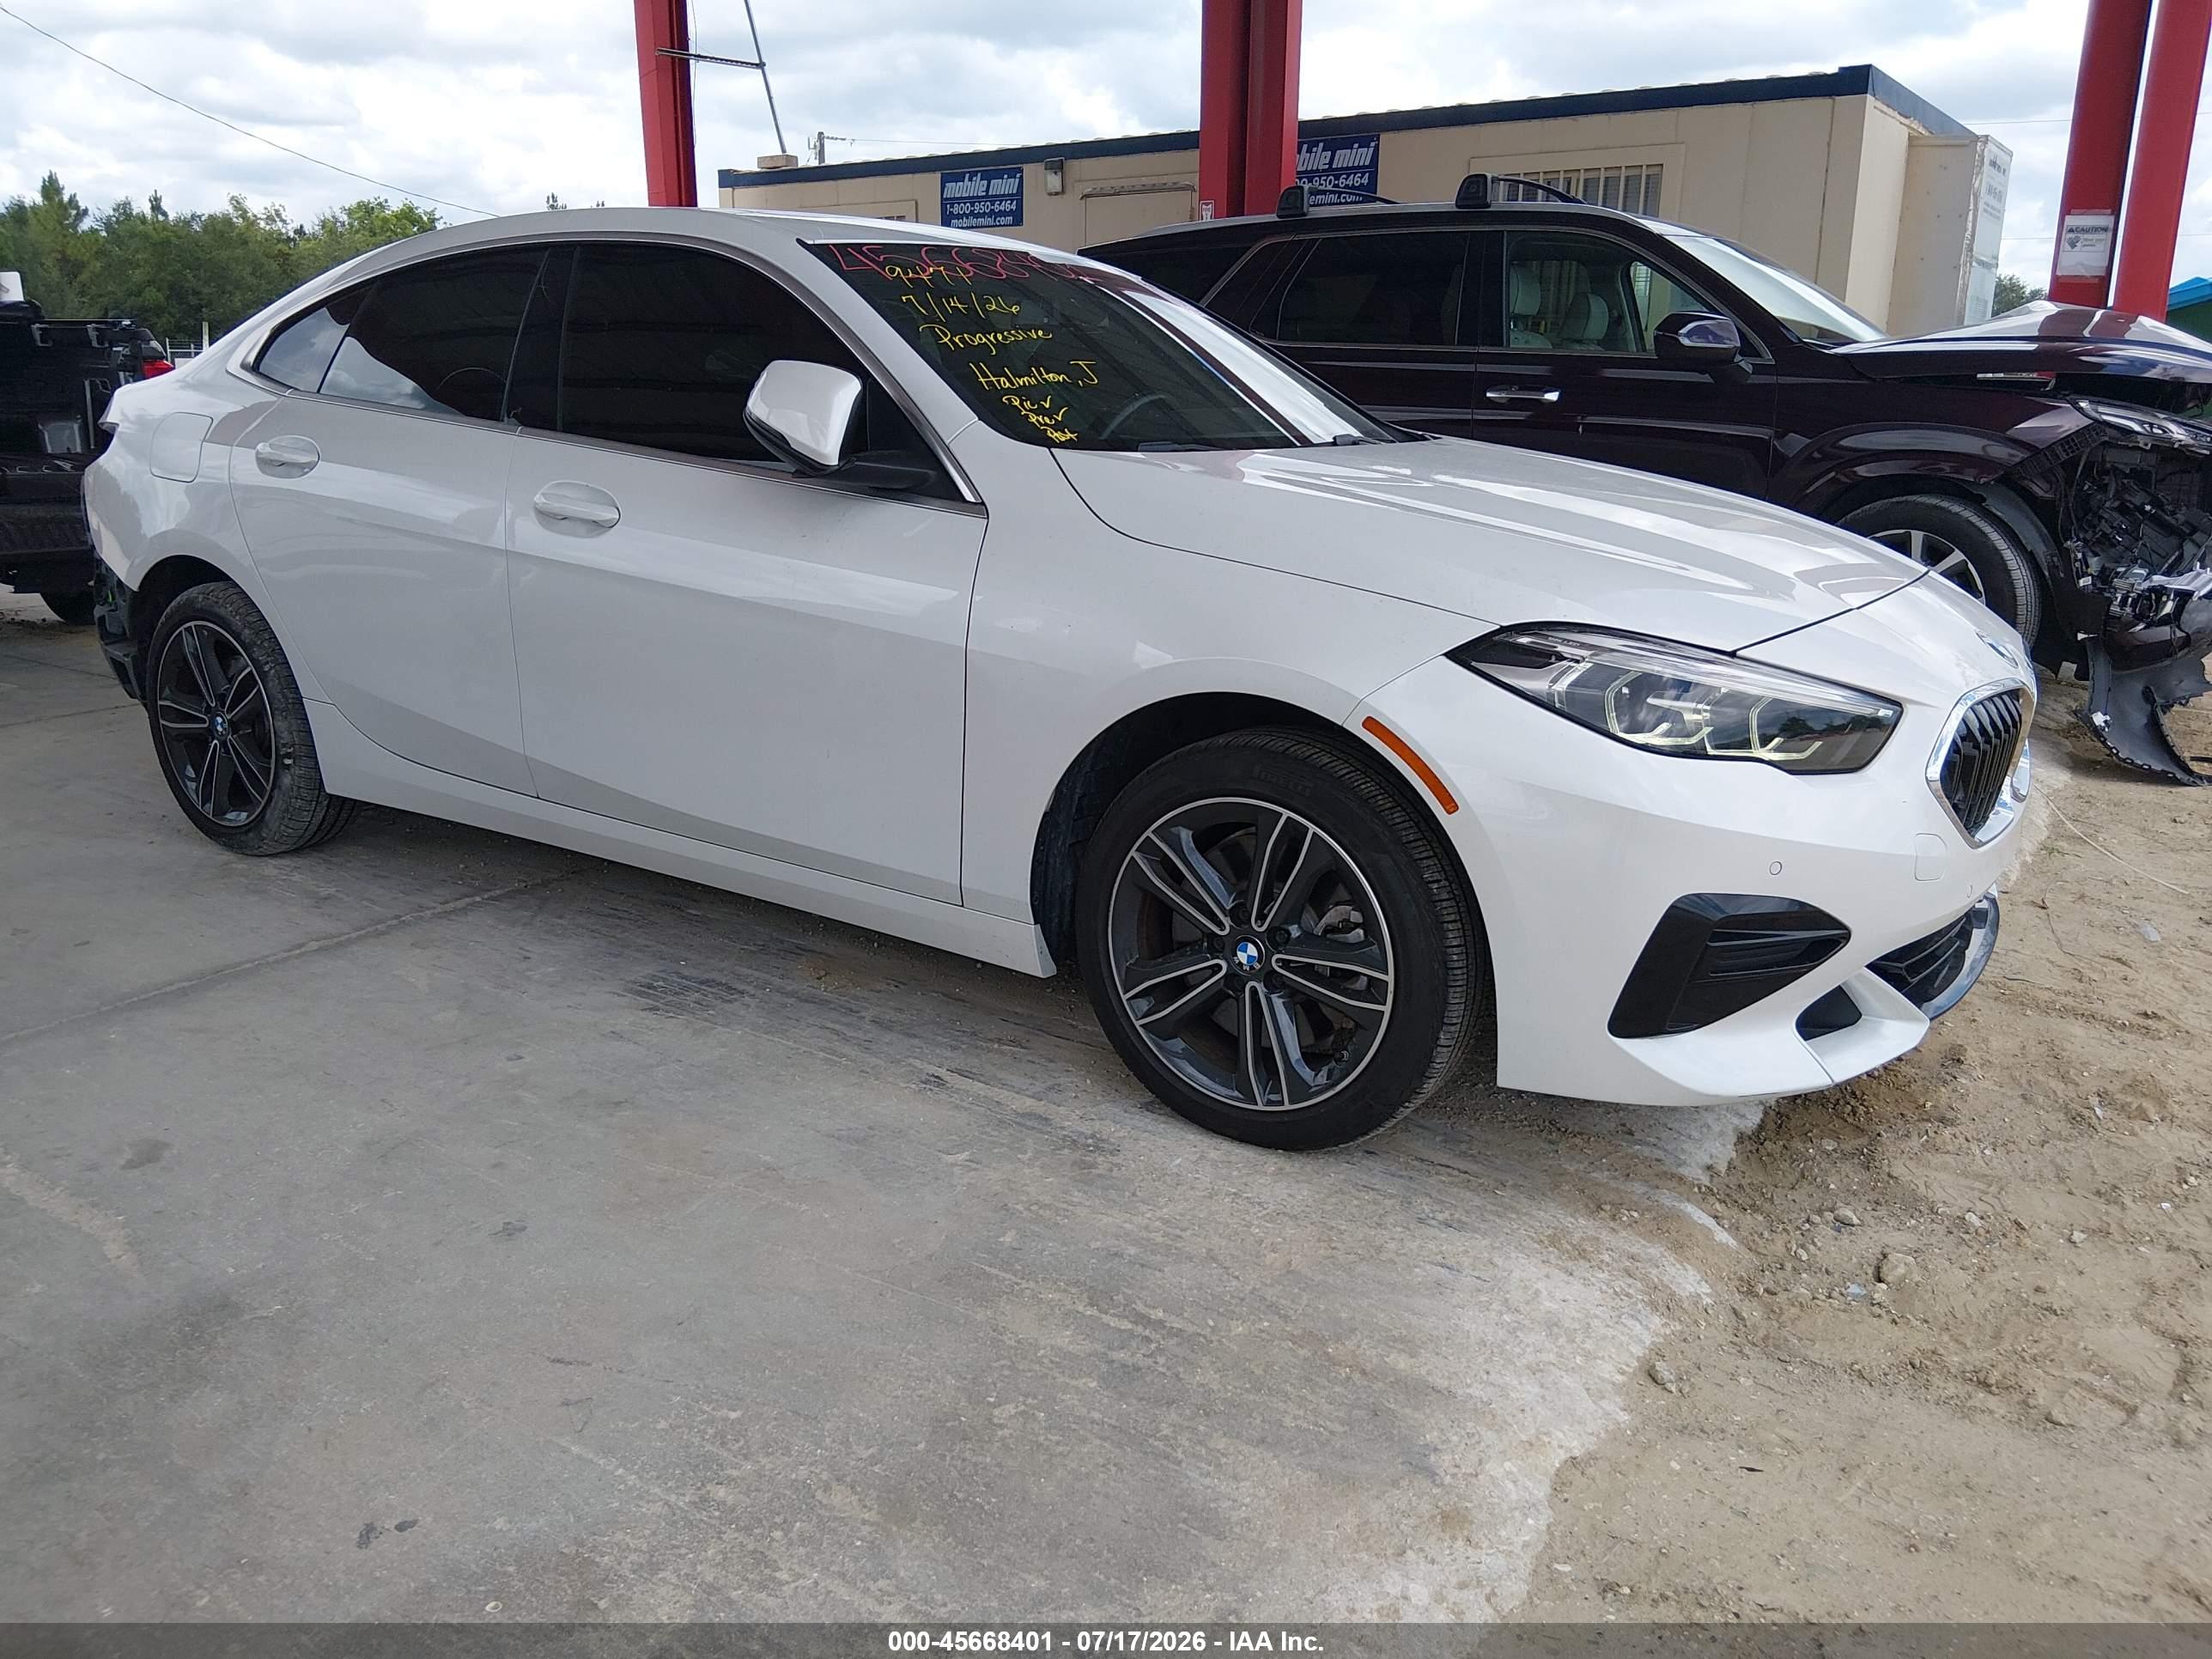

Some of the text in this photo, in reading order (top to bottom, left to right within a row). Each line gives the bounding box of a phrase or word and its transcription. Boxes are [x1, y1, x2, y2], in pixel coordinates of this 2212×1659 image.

[1296, 141, 1376, 172] bile mini
[943, 173, 1023, 198] mobile mini
[946, 199, 1018, 215] 1-800-950-6464
[951, 215, 1013, 228] mobilemini.com
[901, 291, 1020, 322] 7/14/26
[919, 324, 1053, 356] Progressive
